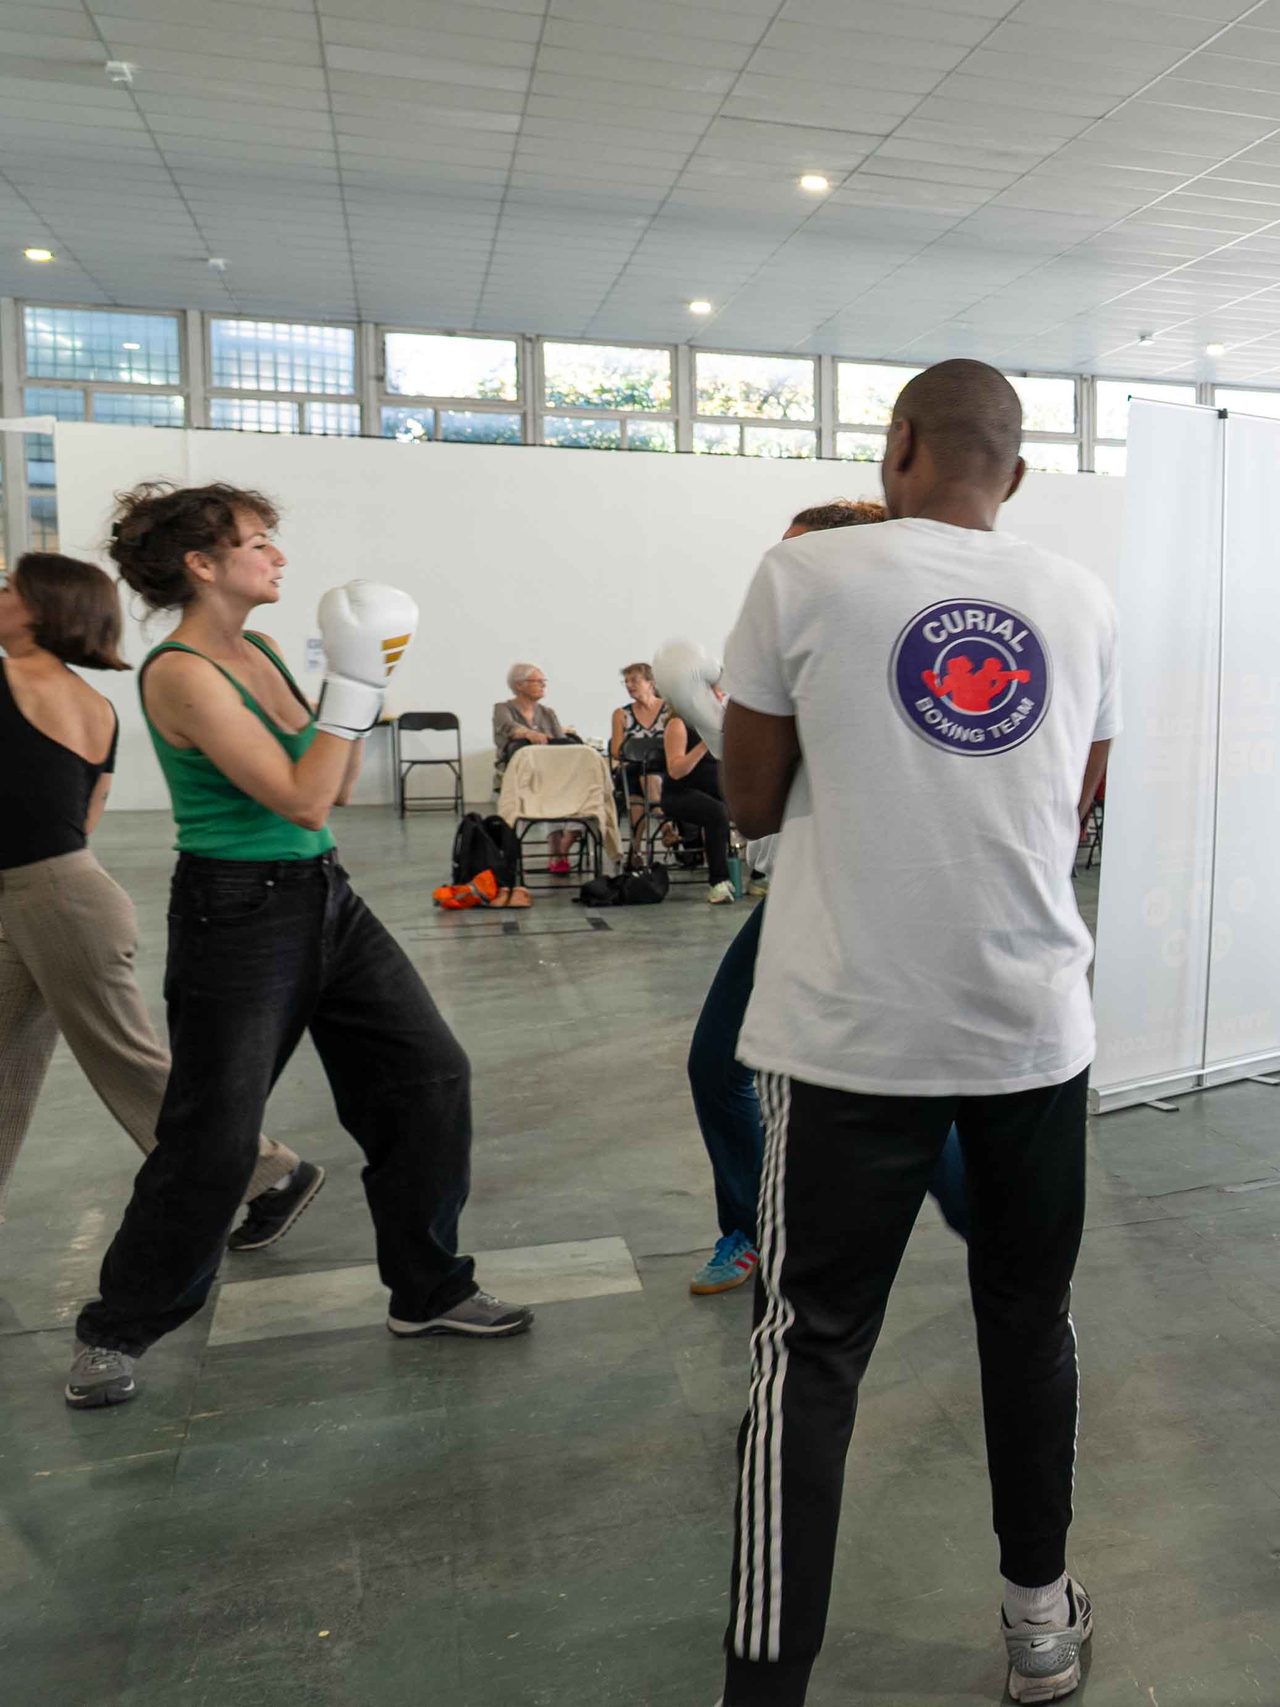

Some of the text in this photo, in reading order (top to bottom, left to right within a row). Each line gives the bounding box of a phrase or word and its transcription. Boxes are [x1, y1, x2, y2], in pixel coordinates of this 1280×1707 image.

[922, 609, 1030, 653] CURIAL
[914, 696, 1036, 743] BOXING TEAM
